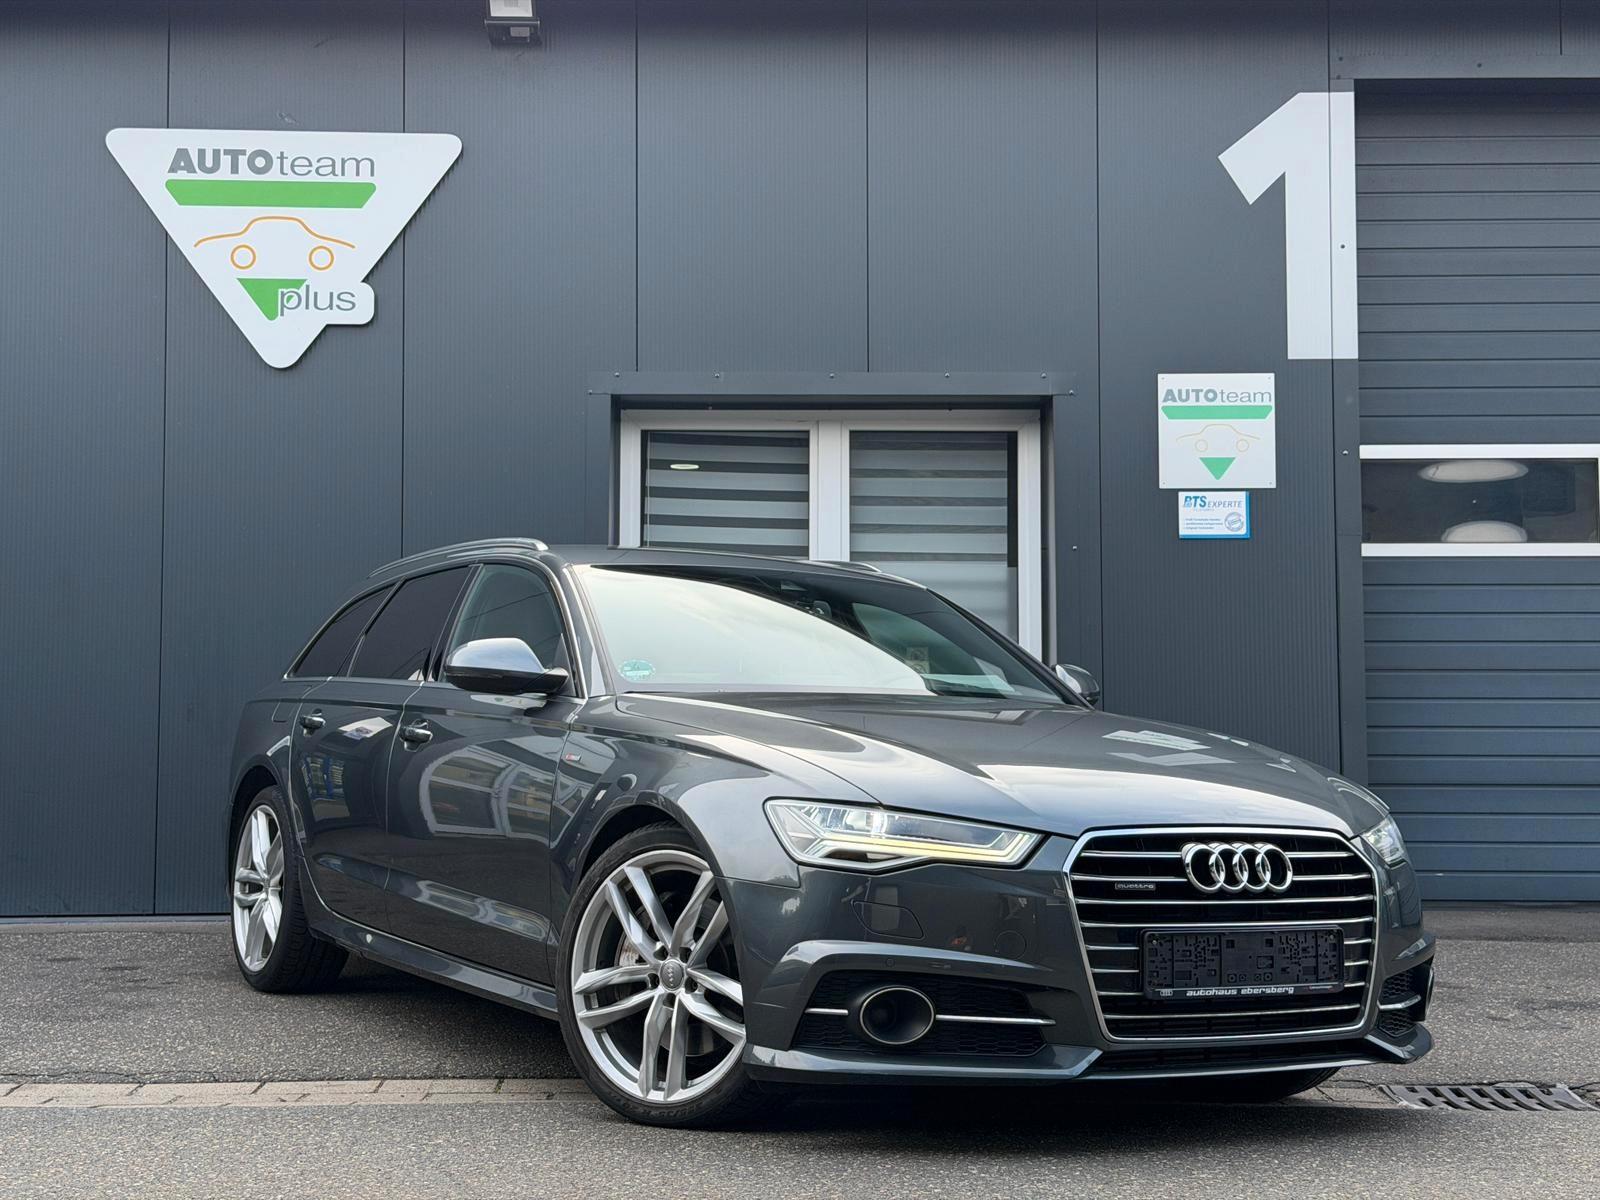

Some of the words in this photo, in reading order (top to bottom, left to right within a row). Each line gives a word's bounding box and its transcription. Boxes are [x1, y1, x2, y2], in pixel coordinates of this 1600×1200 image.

[1218, 91, 1358, 360] 1
[280, 284, 356, 317] plus
[1208, 500, 1242, 508] EXPERTE
[1186, 988, 1237, 996] autohaus
[1241, 986, 1294, 995] ebersberg
